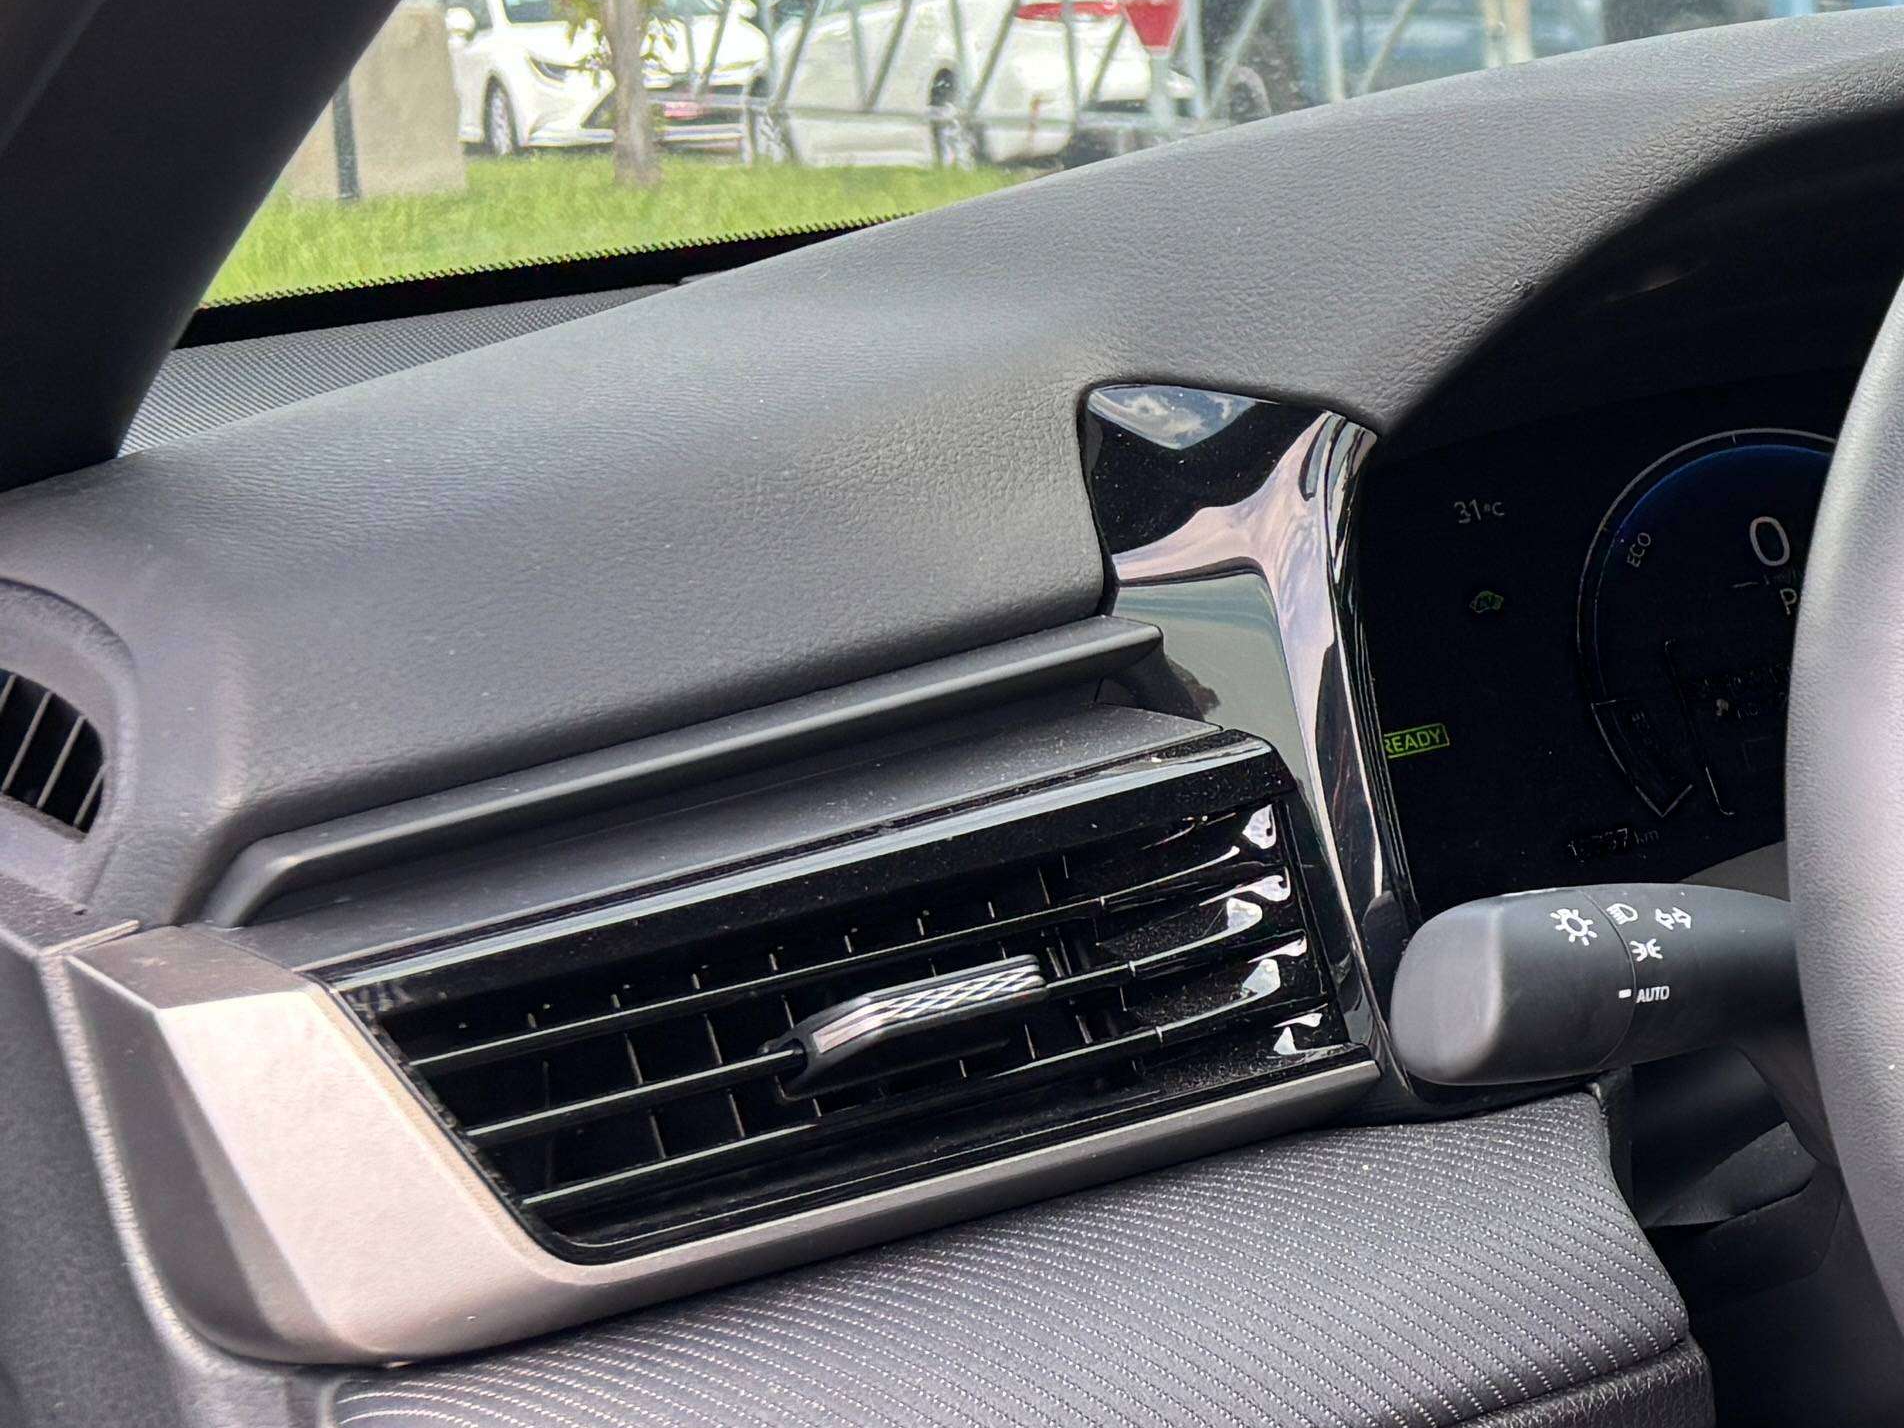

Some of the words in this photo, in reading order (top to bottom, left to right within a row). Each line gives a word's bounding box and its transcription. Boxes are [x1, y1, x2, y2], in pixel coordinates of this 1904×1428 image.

[1626, 531, 1653, 569] ECO
[1749, 516, 1791, 567] 0
[1636, 985, 1670, 1004] AUTO
